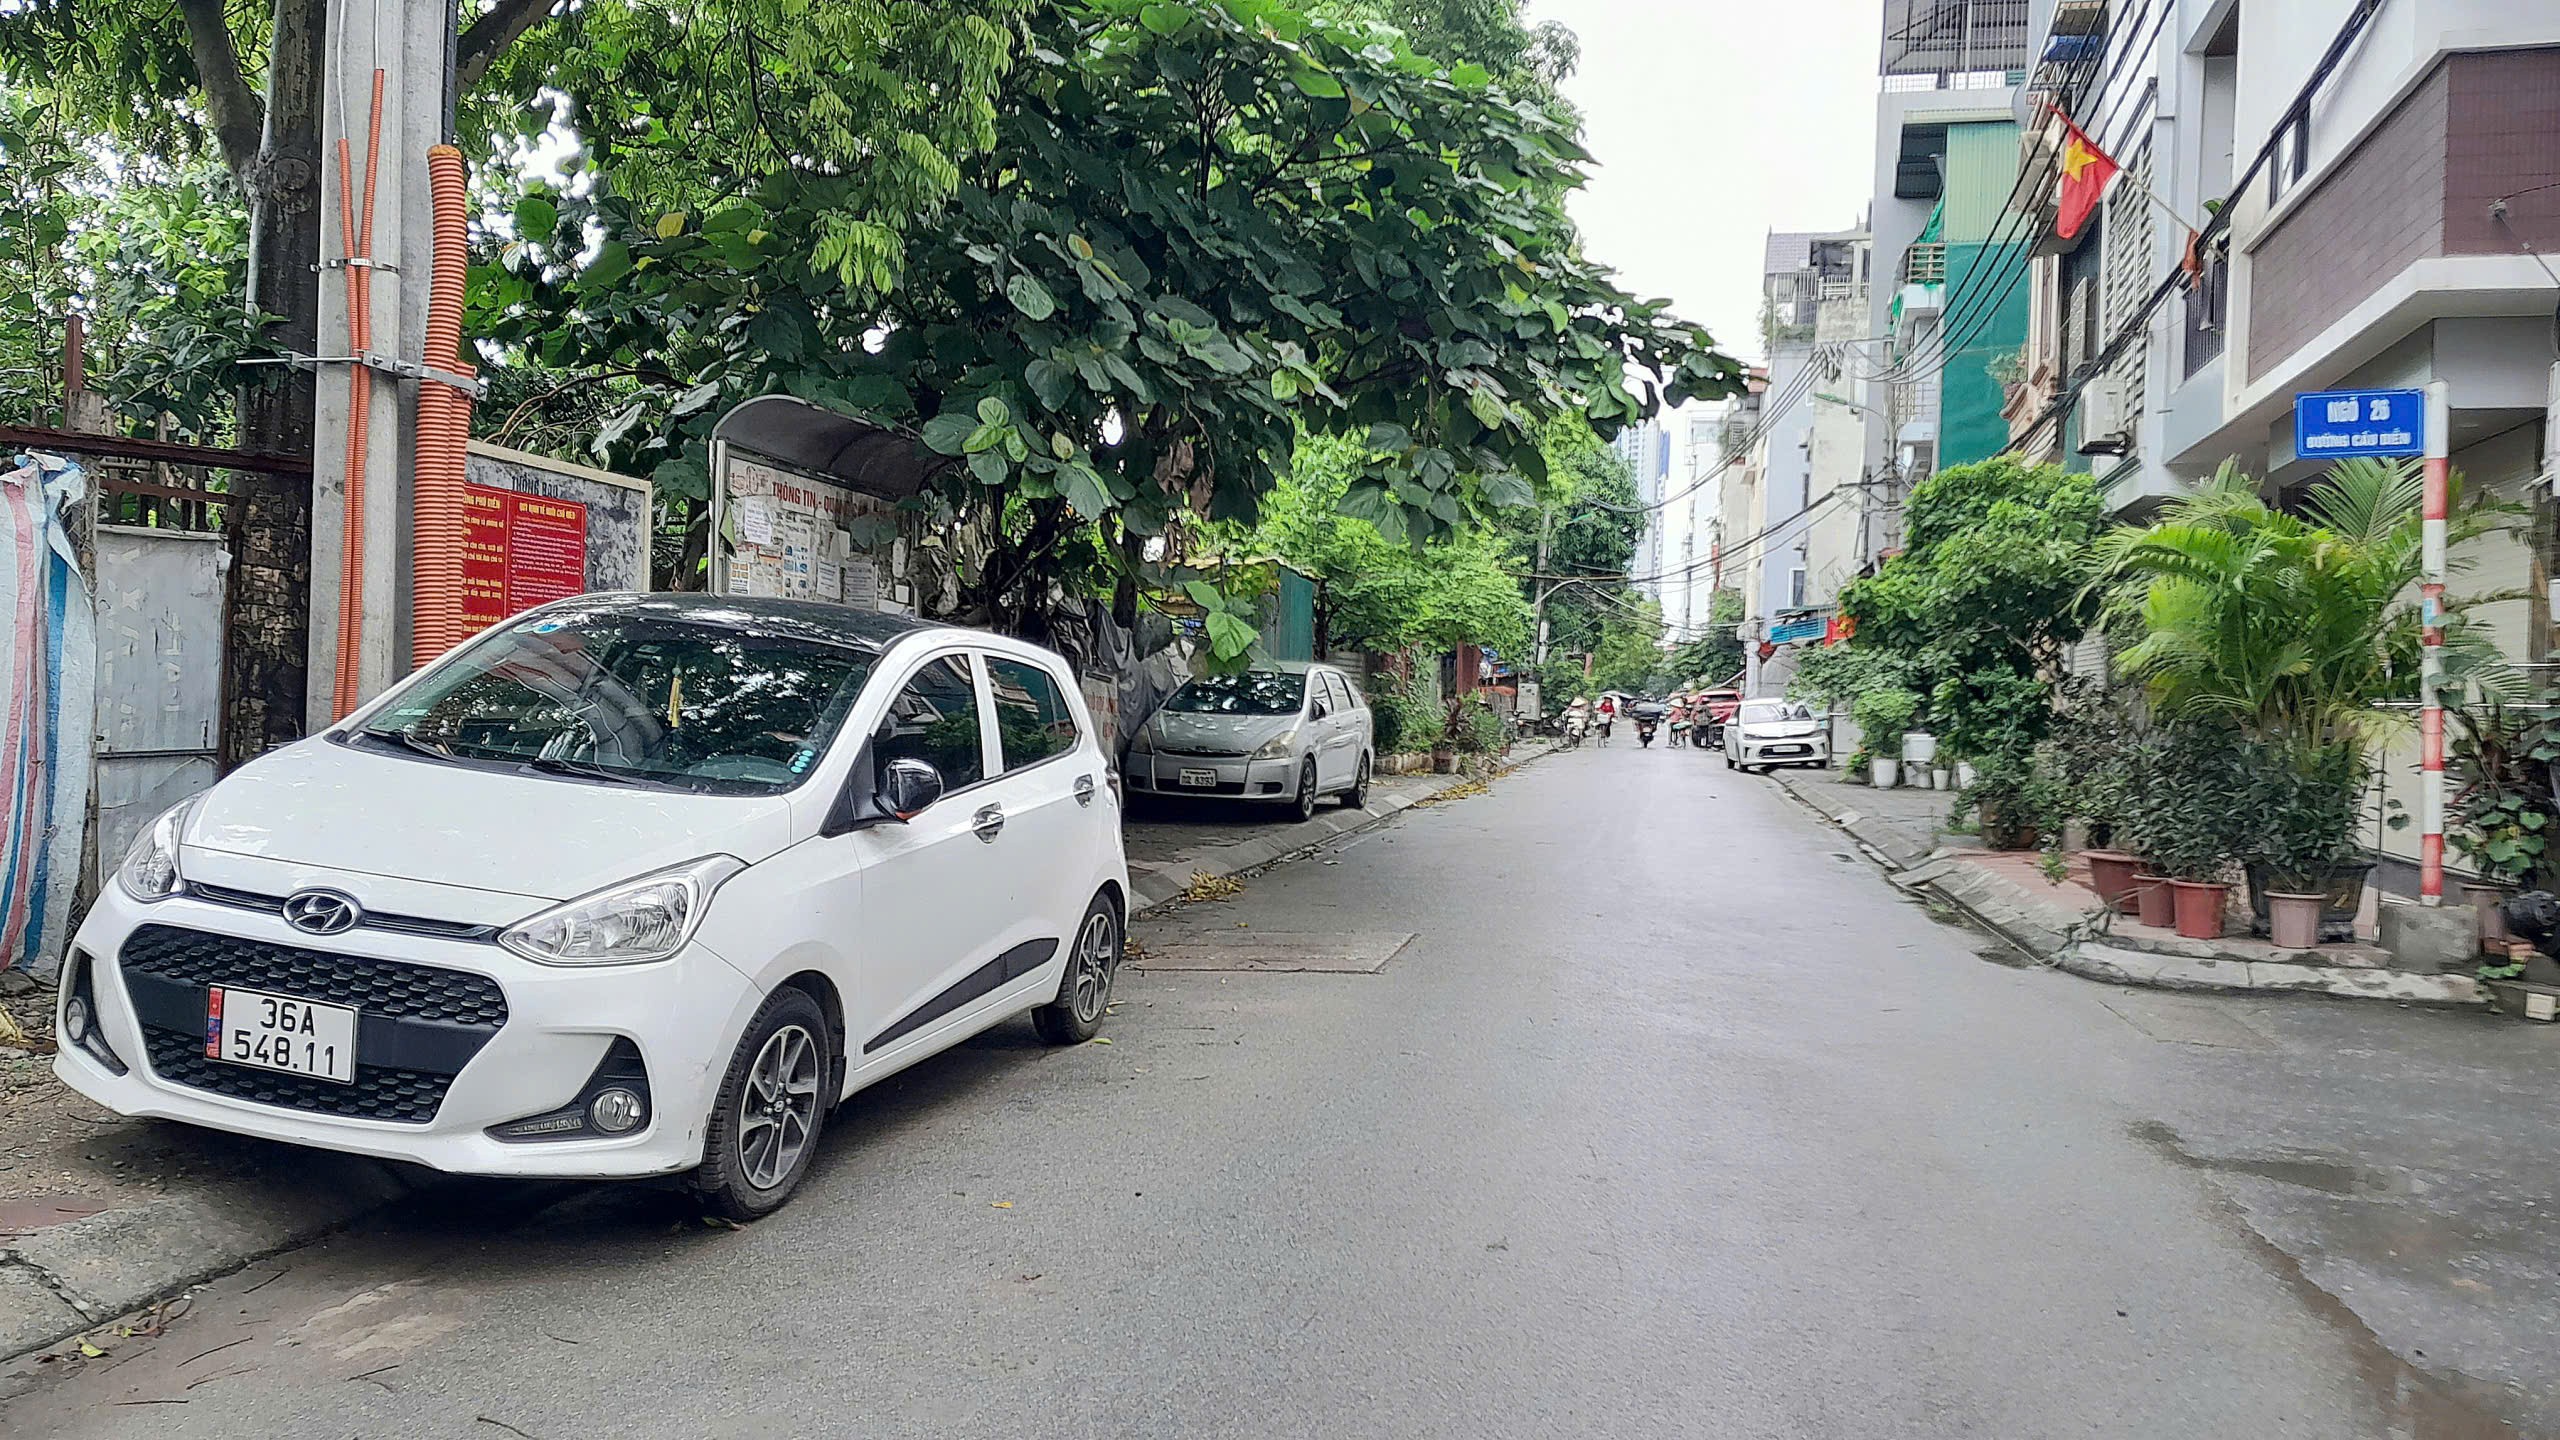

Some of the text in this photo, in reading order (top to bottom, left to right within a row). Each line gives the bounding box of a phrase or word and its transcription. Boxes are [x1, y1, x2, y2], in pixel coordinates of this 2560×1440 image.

[772, 480, 801, 505] THÔNG
[803, 489, 817, 508] TIN
[260, 998, 316, 1036] 36A
[234, 1030, 334, 1075] 548.11
